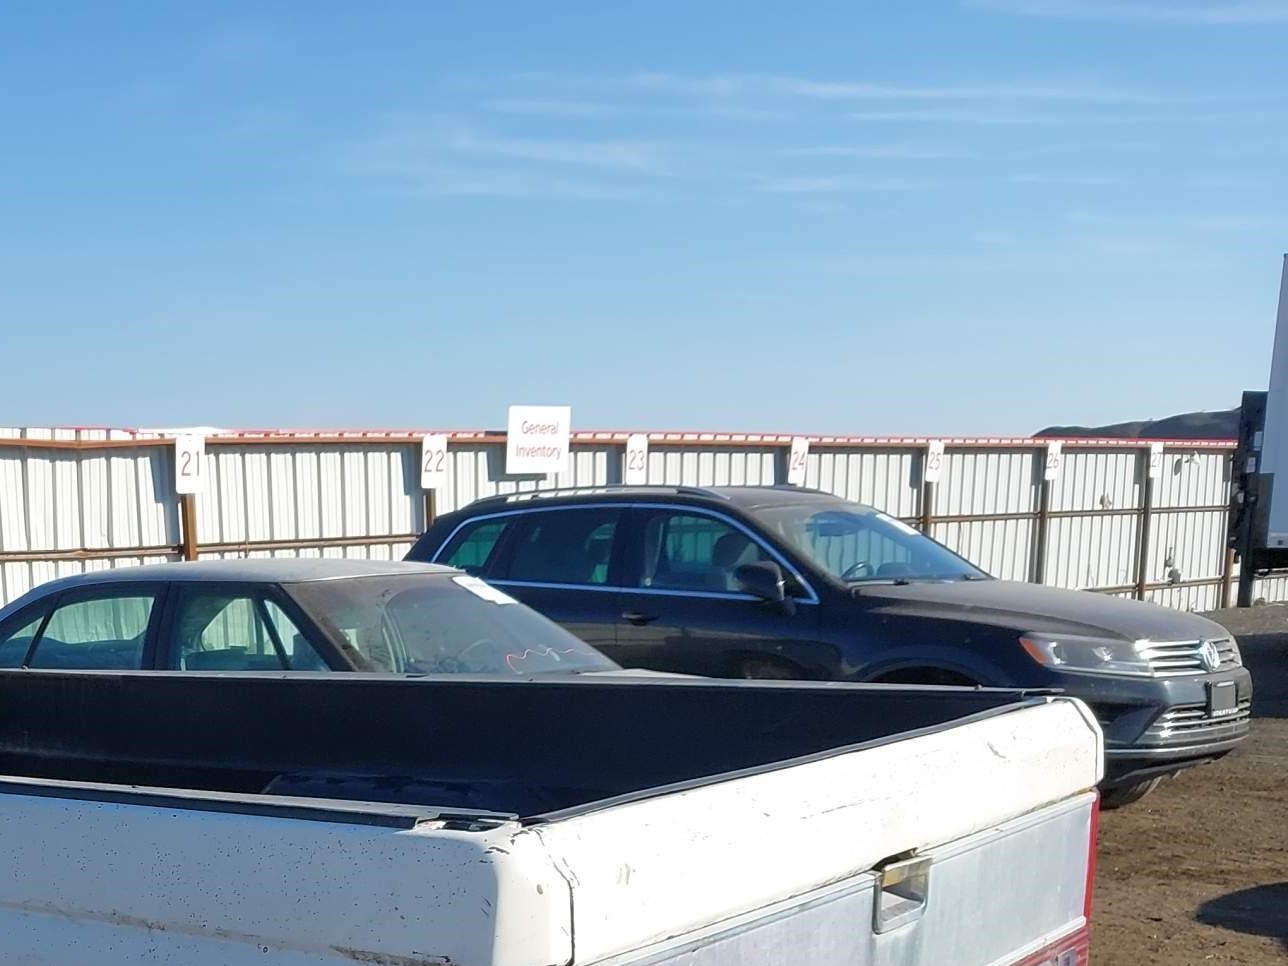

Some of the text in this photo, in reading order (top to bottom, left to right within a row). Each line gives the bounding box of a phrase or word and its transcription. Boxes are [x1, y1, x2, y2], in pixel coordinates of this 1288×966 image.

[521, 420, 560, 434] General
[424, 449, 444, 472] 22
[515, 443, 561, 460] Inventory
[628, 450, 644, 470] 23
[928, 451, 941, 470] 25
[181, 450, 200, 477] 21
